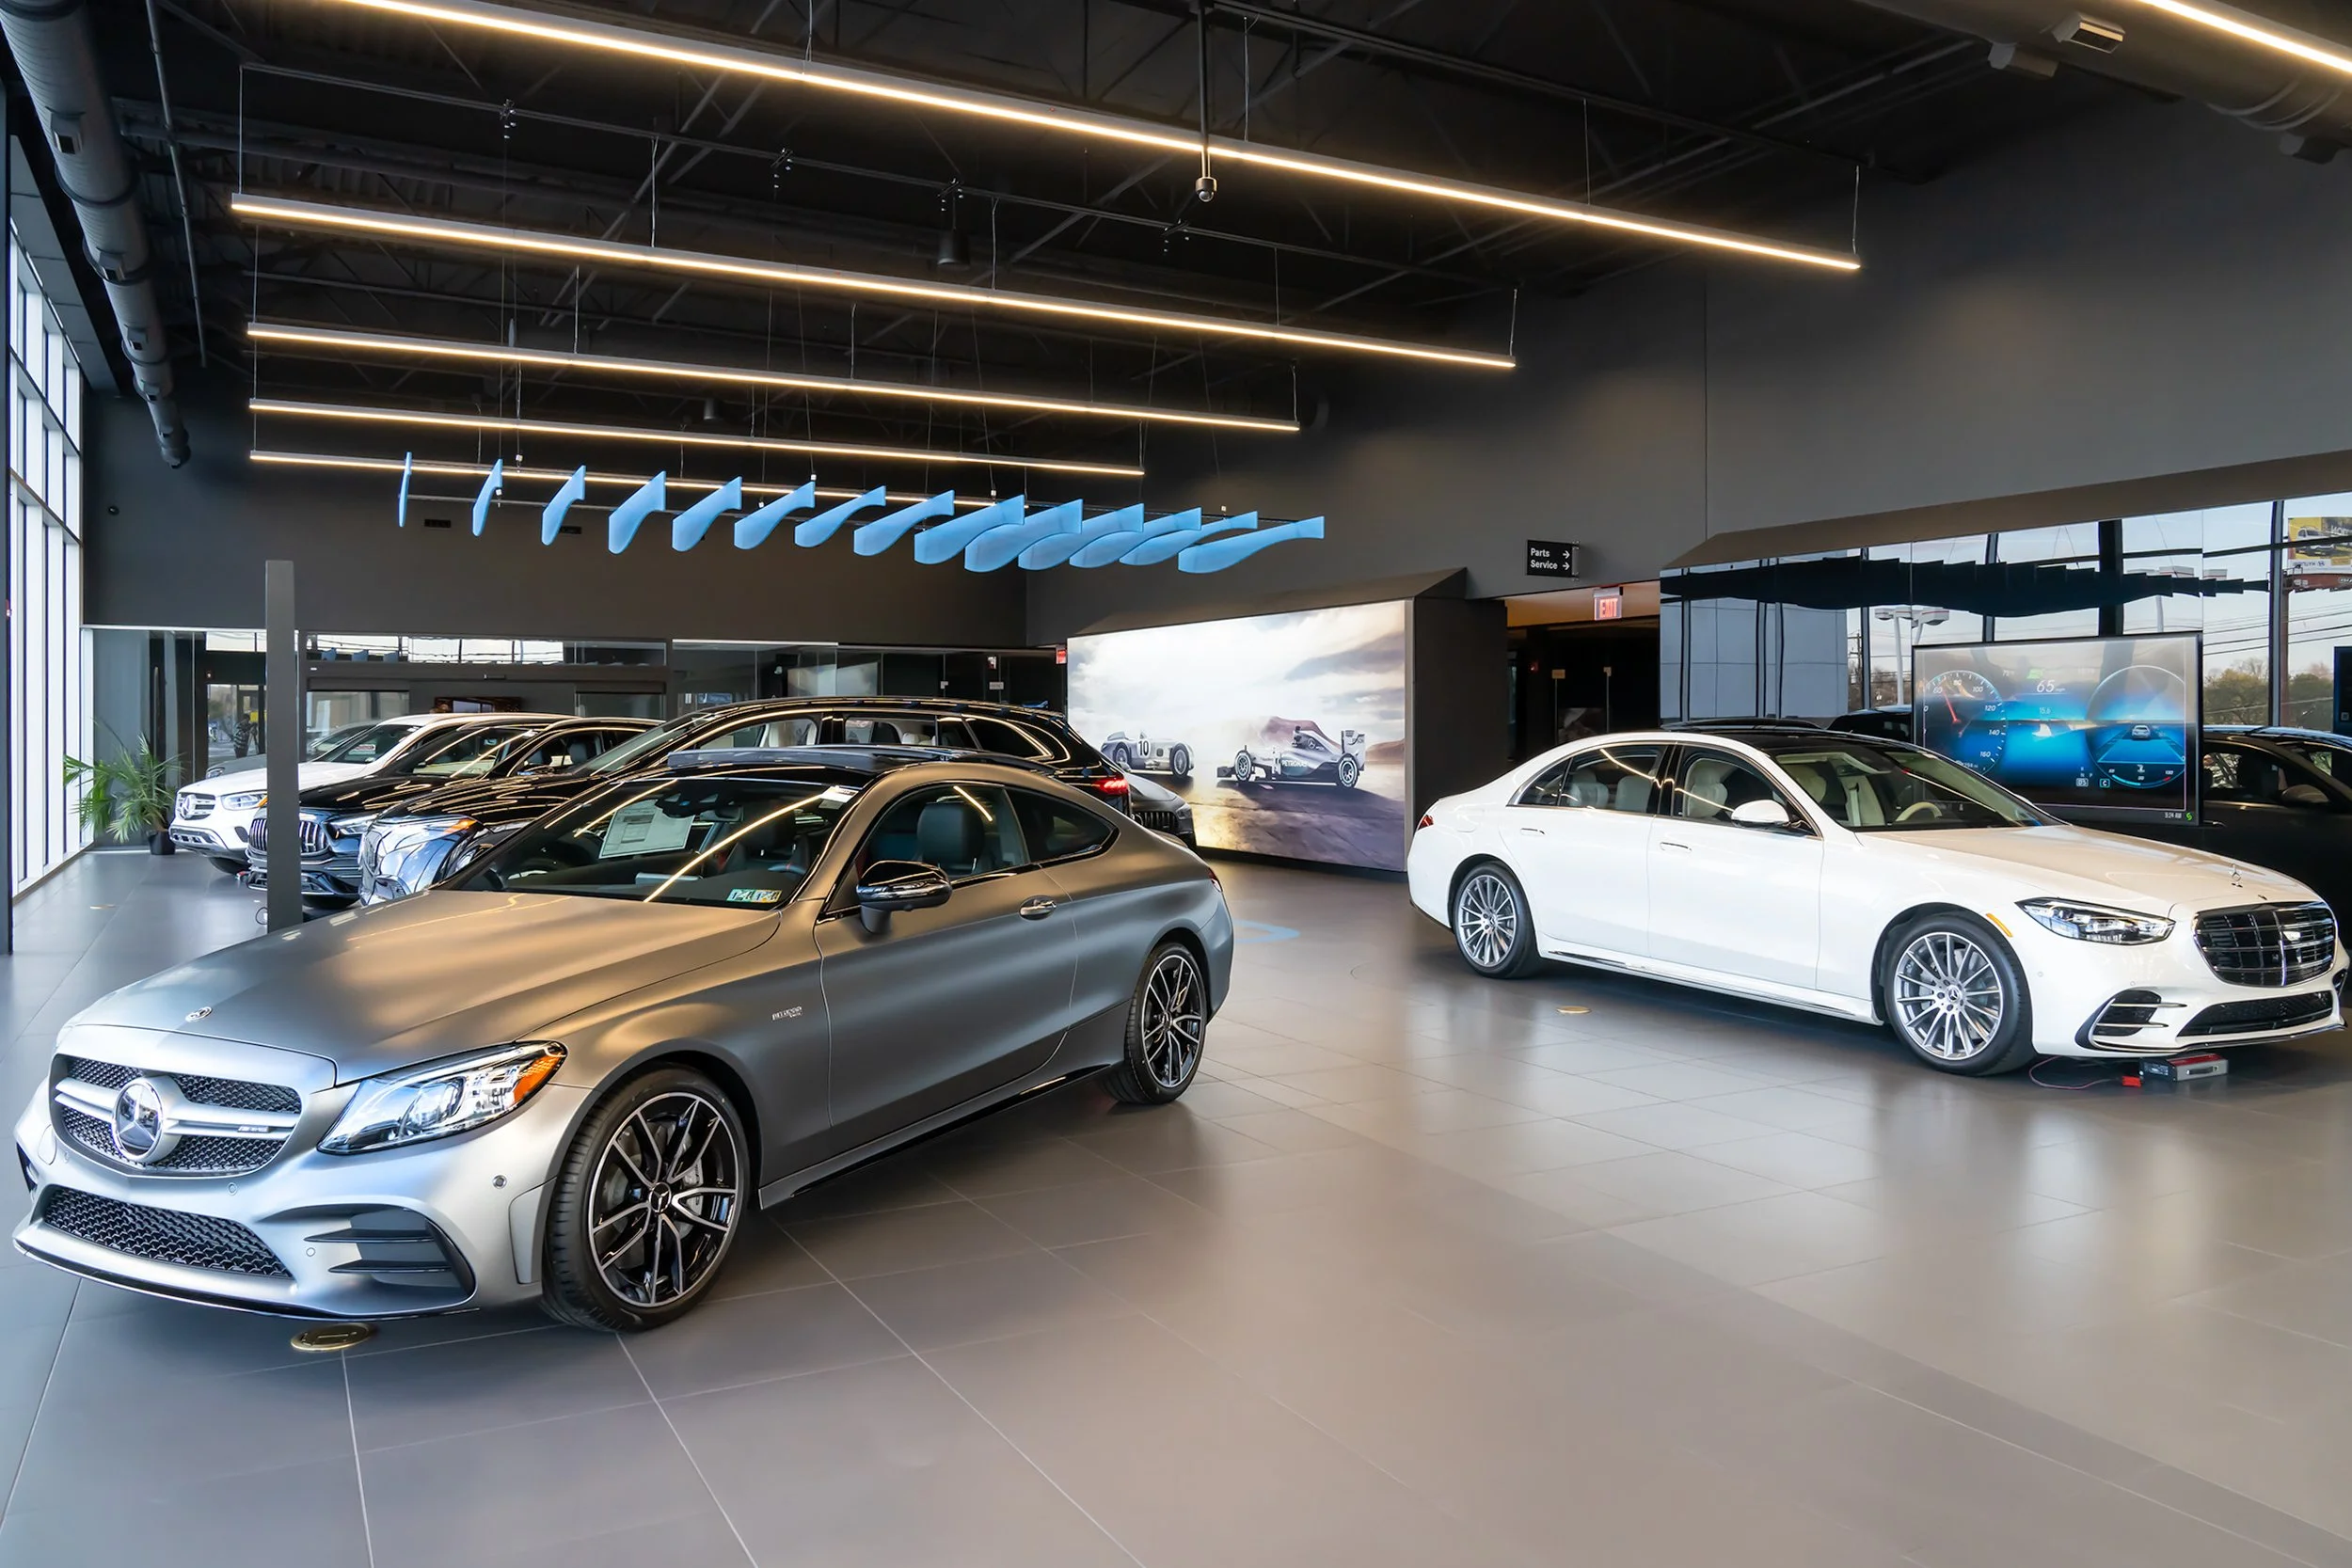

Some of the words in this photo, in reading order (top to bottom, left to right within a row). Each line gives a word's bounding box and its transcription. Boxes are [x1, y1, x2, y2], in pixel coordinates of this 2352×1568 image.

[1531, 547, 1549, 557] Parts
[1531, 560, 1558, 569] Service
[1600, 598, 1618, 618] EXIT
[2037, 679, 2055, 692] 65
[1138, 740, 1149, 756] 10
